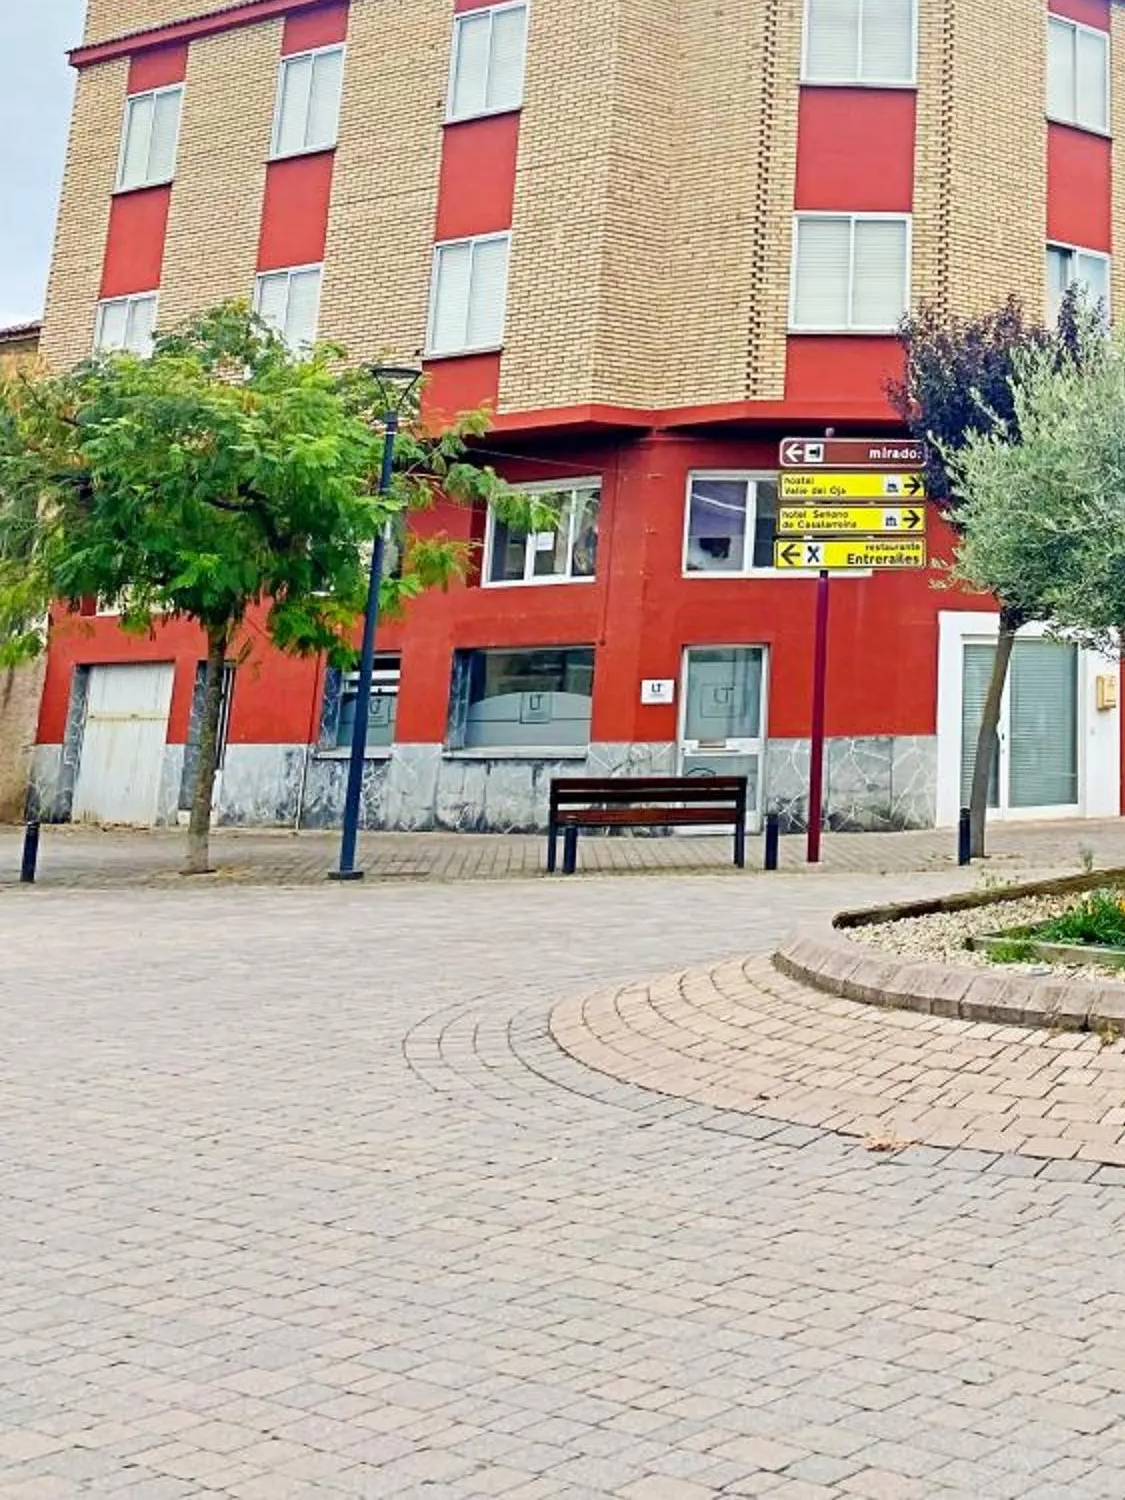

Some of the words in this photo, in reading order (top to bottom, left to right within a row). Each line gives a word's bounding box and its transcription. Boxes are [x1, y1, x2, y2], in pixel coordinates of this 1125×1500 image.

[784, 476, 815, 485] hostal
[811, 486, 826, 494] del
[782, 510, 807, 519] hotel
[865, 542, 920, 551] restaurante
